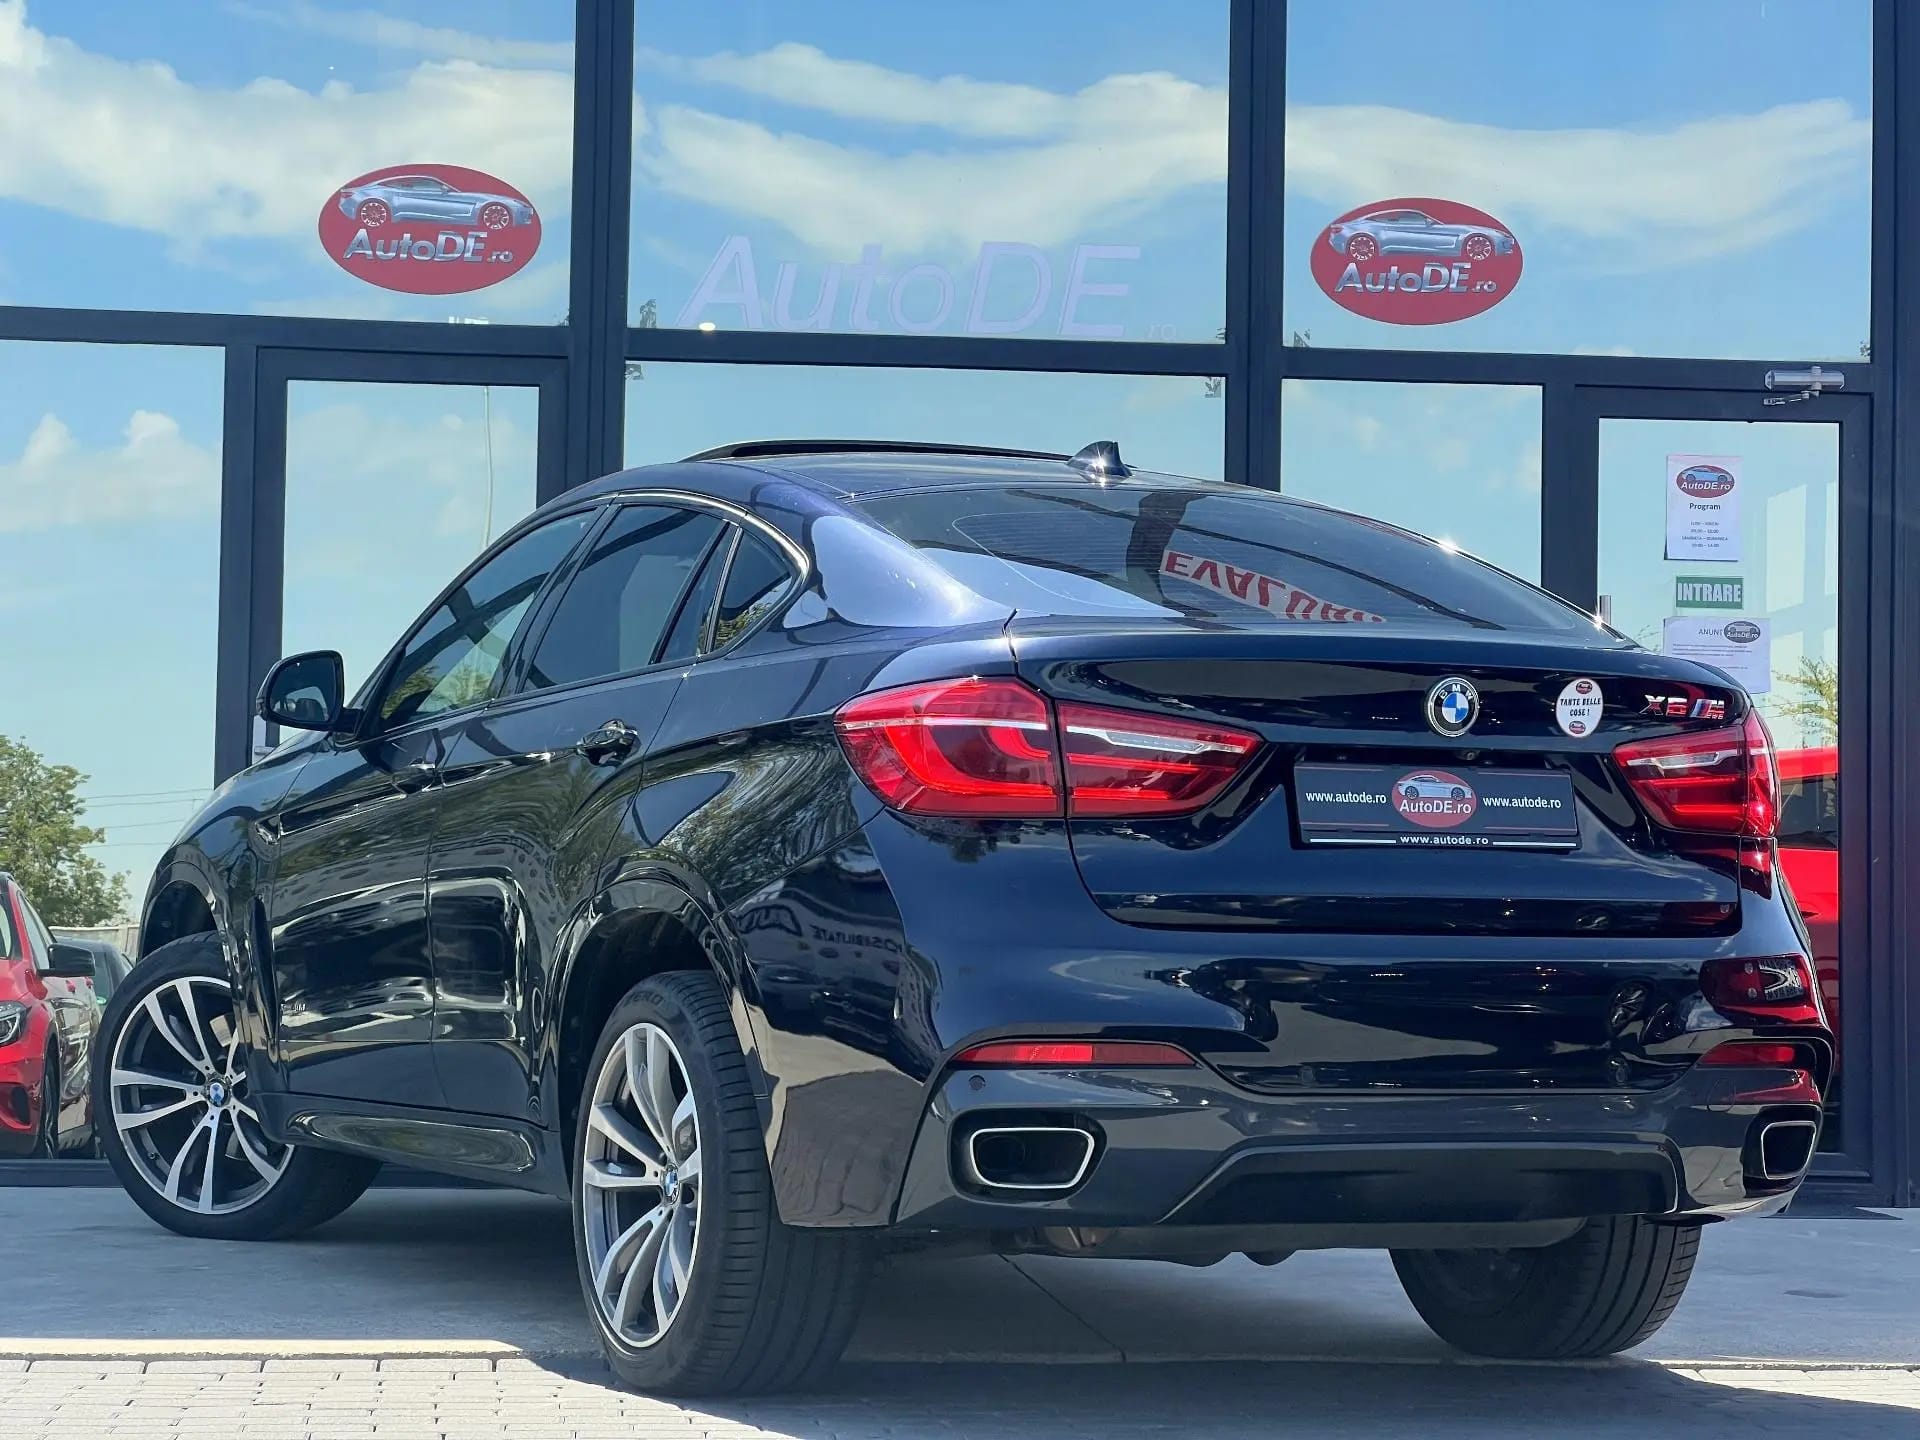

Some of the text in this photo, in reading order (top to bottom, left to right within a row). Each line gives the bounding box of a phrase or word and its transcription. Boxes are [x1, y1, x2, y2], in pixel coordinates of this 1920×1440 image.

[1680, 481, 1731, 491] AutoDE.ro
[1689, 502, 1721, 511] Program
[1677, 582, 1741, 602] INTRARE
[1560, 697, 1602, 706] TANTE BELLE
[1305, 790, 1387, 804] www.autode.ro
[1482, 796, 1562, 809] www.autode.ro
[1399, 799, 1472, 814] AutoDE.ro
[1399, 834, 1489, 846] www.autode.ro
